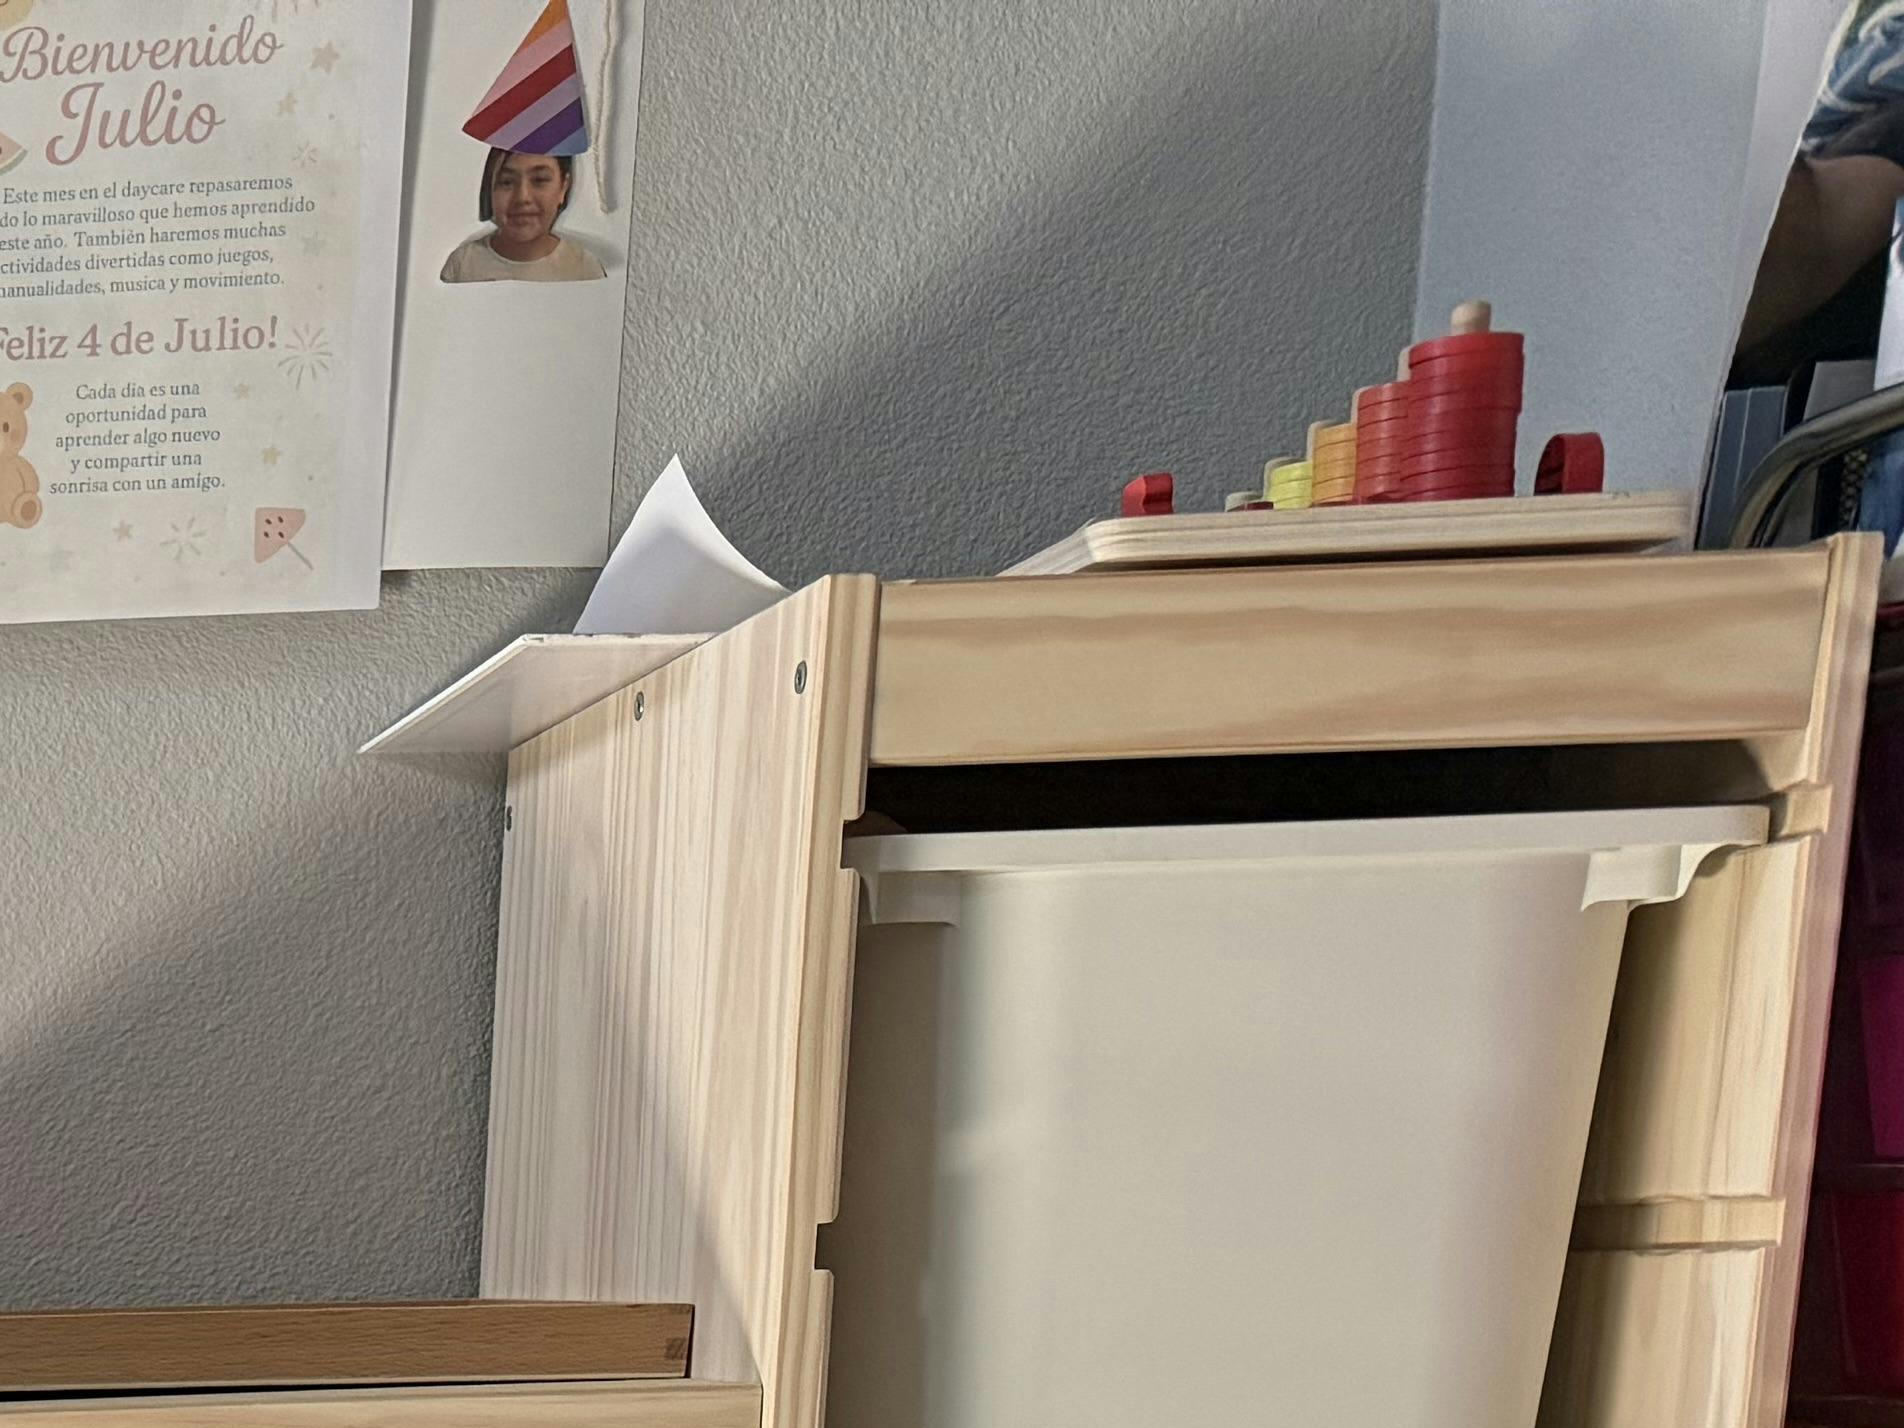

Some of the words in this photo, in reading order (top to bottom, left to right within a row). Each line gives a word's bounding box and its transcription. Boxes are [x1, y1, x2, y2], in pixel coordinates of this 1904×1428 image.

[45, 80, 226, 166] Julio
[3, 188, 39, 205] Este
[43, 189, 76, 202] mes
[79, 187, 98, 200] en
[103, 182, 117, 199] el
[122, 181, 185, 200] daycare
[189, 177, 293, 197] repasaremos
[23, 211, 38, 227] lo
[42, 207, 135, 226] maravilloso
[139, 205, 169, 224] que
[173, 201, 228, 219] hemos
[231, 196, 315, 219] aprendido
[34, 234, 68, 250] año.
[74, 229, 145, 247] También
[150, 227, 219, 244] haremos
[223, 221, 286, 240] muchas
[85, 251, 165, 270] divertidas
[169, 252, 213, 266] como
[217, 248, 274, 267] juegos,
[110, 275, 166, 293] musica
[169, 278, 179, 294] y
[183, 271, 285, 289] movimiento.
[76, 323, 102, 357] 4
[110, 320, 155, 356] de
[164, 315, 278, 353] Julio!
[76, 383, 116, 400] Cada
[150, 384, 166, 397] es
[170, 384, 200, 396] una
[65, 404, 166, 428] oportunidad
[171, 407, 207, 424] para
[55, 429, 130, 451] aprender
[133, 427, 167, 448] algo
[171, 430, 221, 443] nuevo
[70, 459, 80, 474] y
[85, 451, 167, 473] compartir
[171, 454, 202, 466] una
[49, 477, 108, 494] sonrisa
[112, 479, 141, 492] con
[146, 477, 166, 490] un
[171, 473, 225, 492] amigo.
